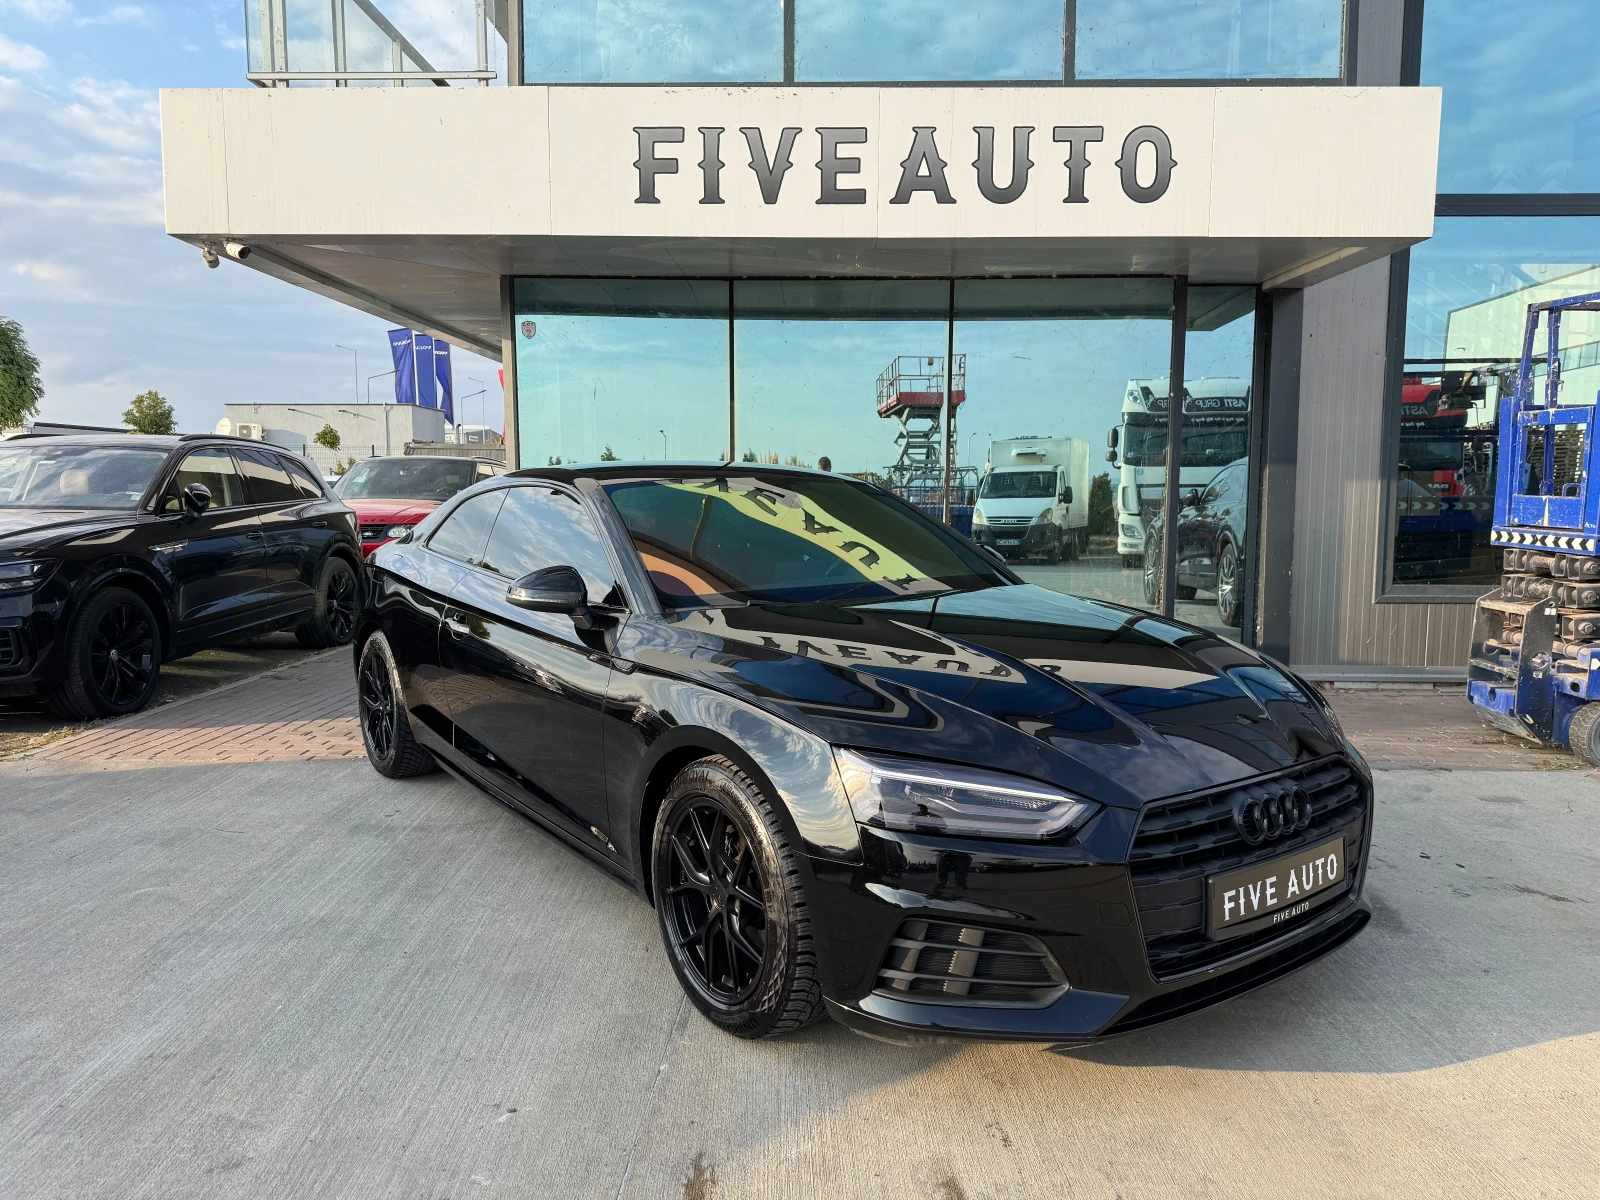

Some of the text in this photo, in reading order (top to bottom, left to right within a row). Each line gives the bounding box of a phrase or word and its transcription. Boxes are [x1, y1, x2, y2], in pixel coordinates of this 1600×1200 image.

[1222, 853, 1338, 922] FIVE AUTO
[1273, 901, 1310, 924] FIVE AUTO
